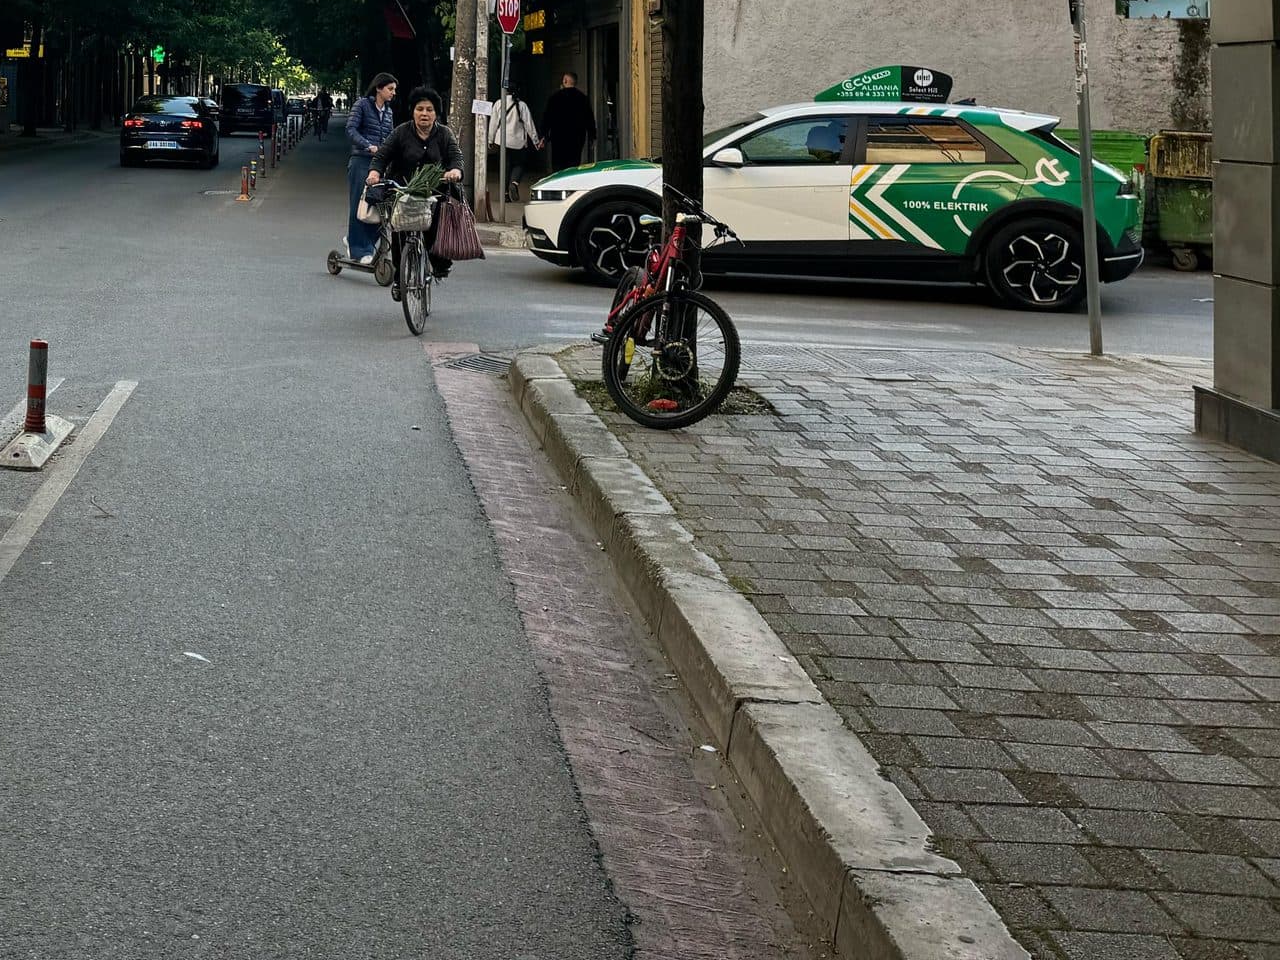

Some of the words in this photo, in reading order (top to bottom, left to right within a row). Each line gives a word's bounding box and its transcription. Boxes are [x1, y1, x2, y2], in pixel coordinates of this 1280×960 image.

[861, 84, 899, 92] ALBANIA
[903, 200, 931, 209] 100%
[933, 201, 989, 212] ELEKTRIK
